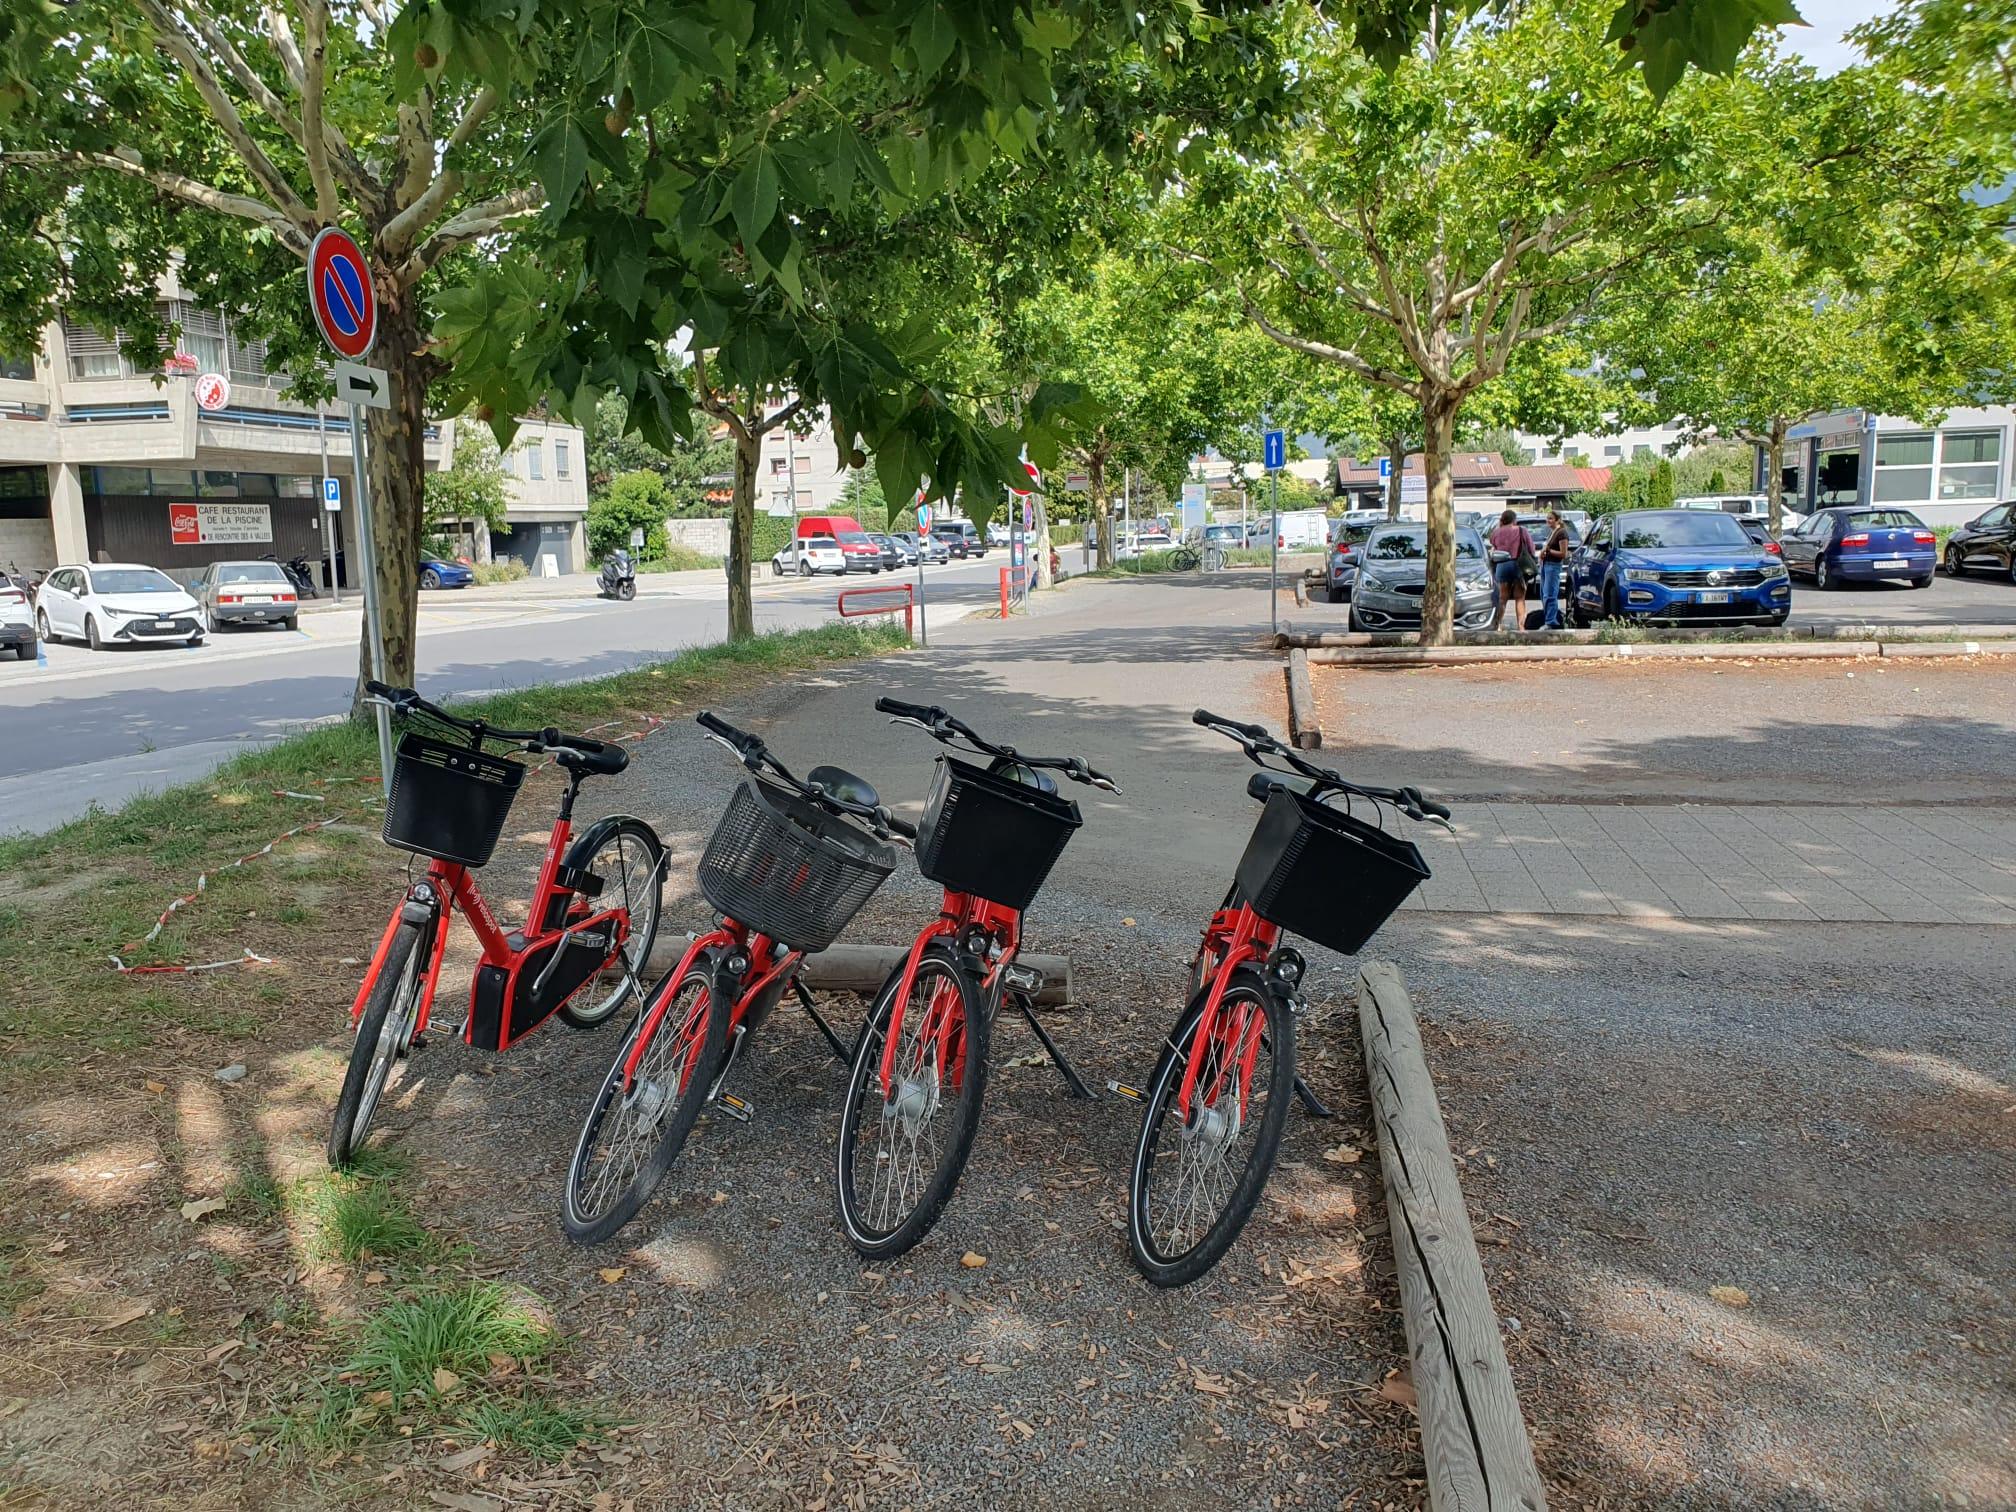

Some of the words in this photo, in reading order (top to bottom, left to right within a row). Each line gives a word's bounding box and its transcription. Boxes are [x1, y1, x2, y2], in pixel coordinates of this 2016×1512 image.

[328, 483, 336, 499] P
[198, 506, 218, 515] CAFE
[222, 506, 268, 515] RESTAURANT
[207, 516, 217, 524] DE
[221, 516, 231, 524] LA
[235, 516, 263, 524] PISCINE
